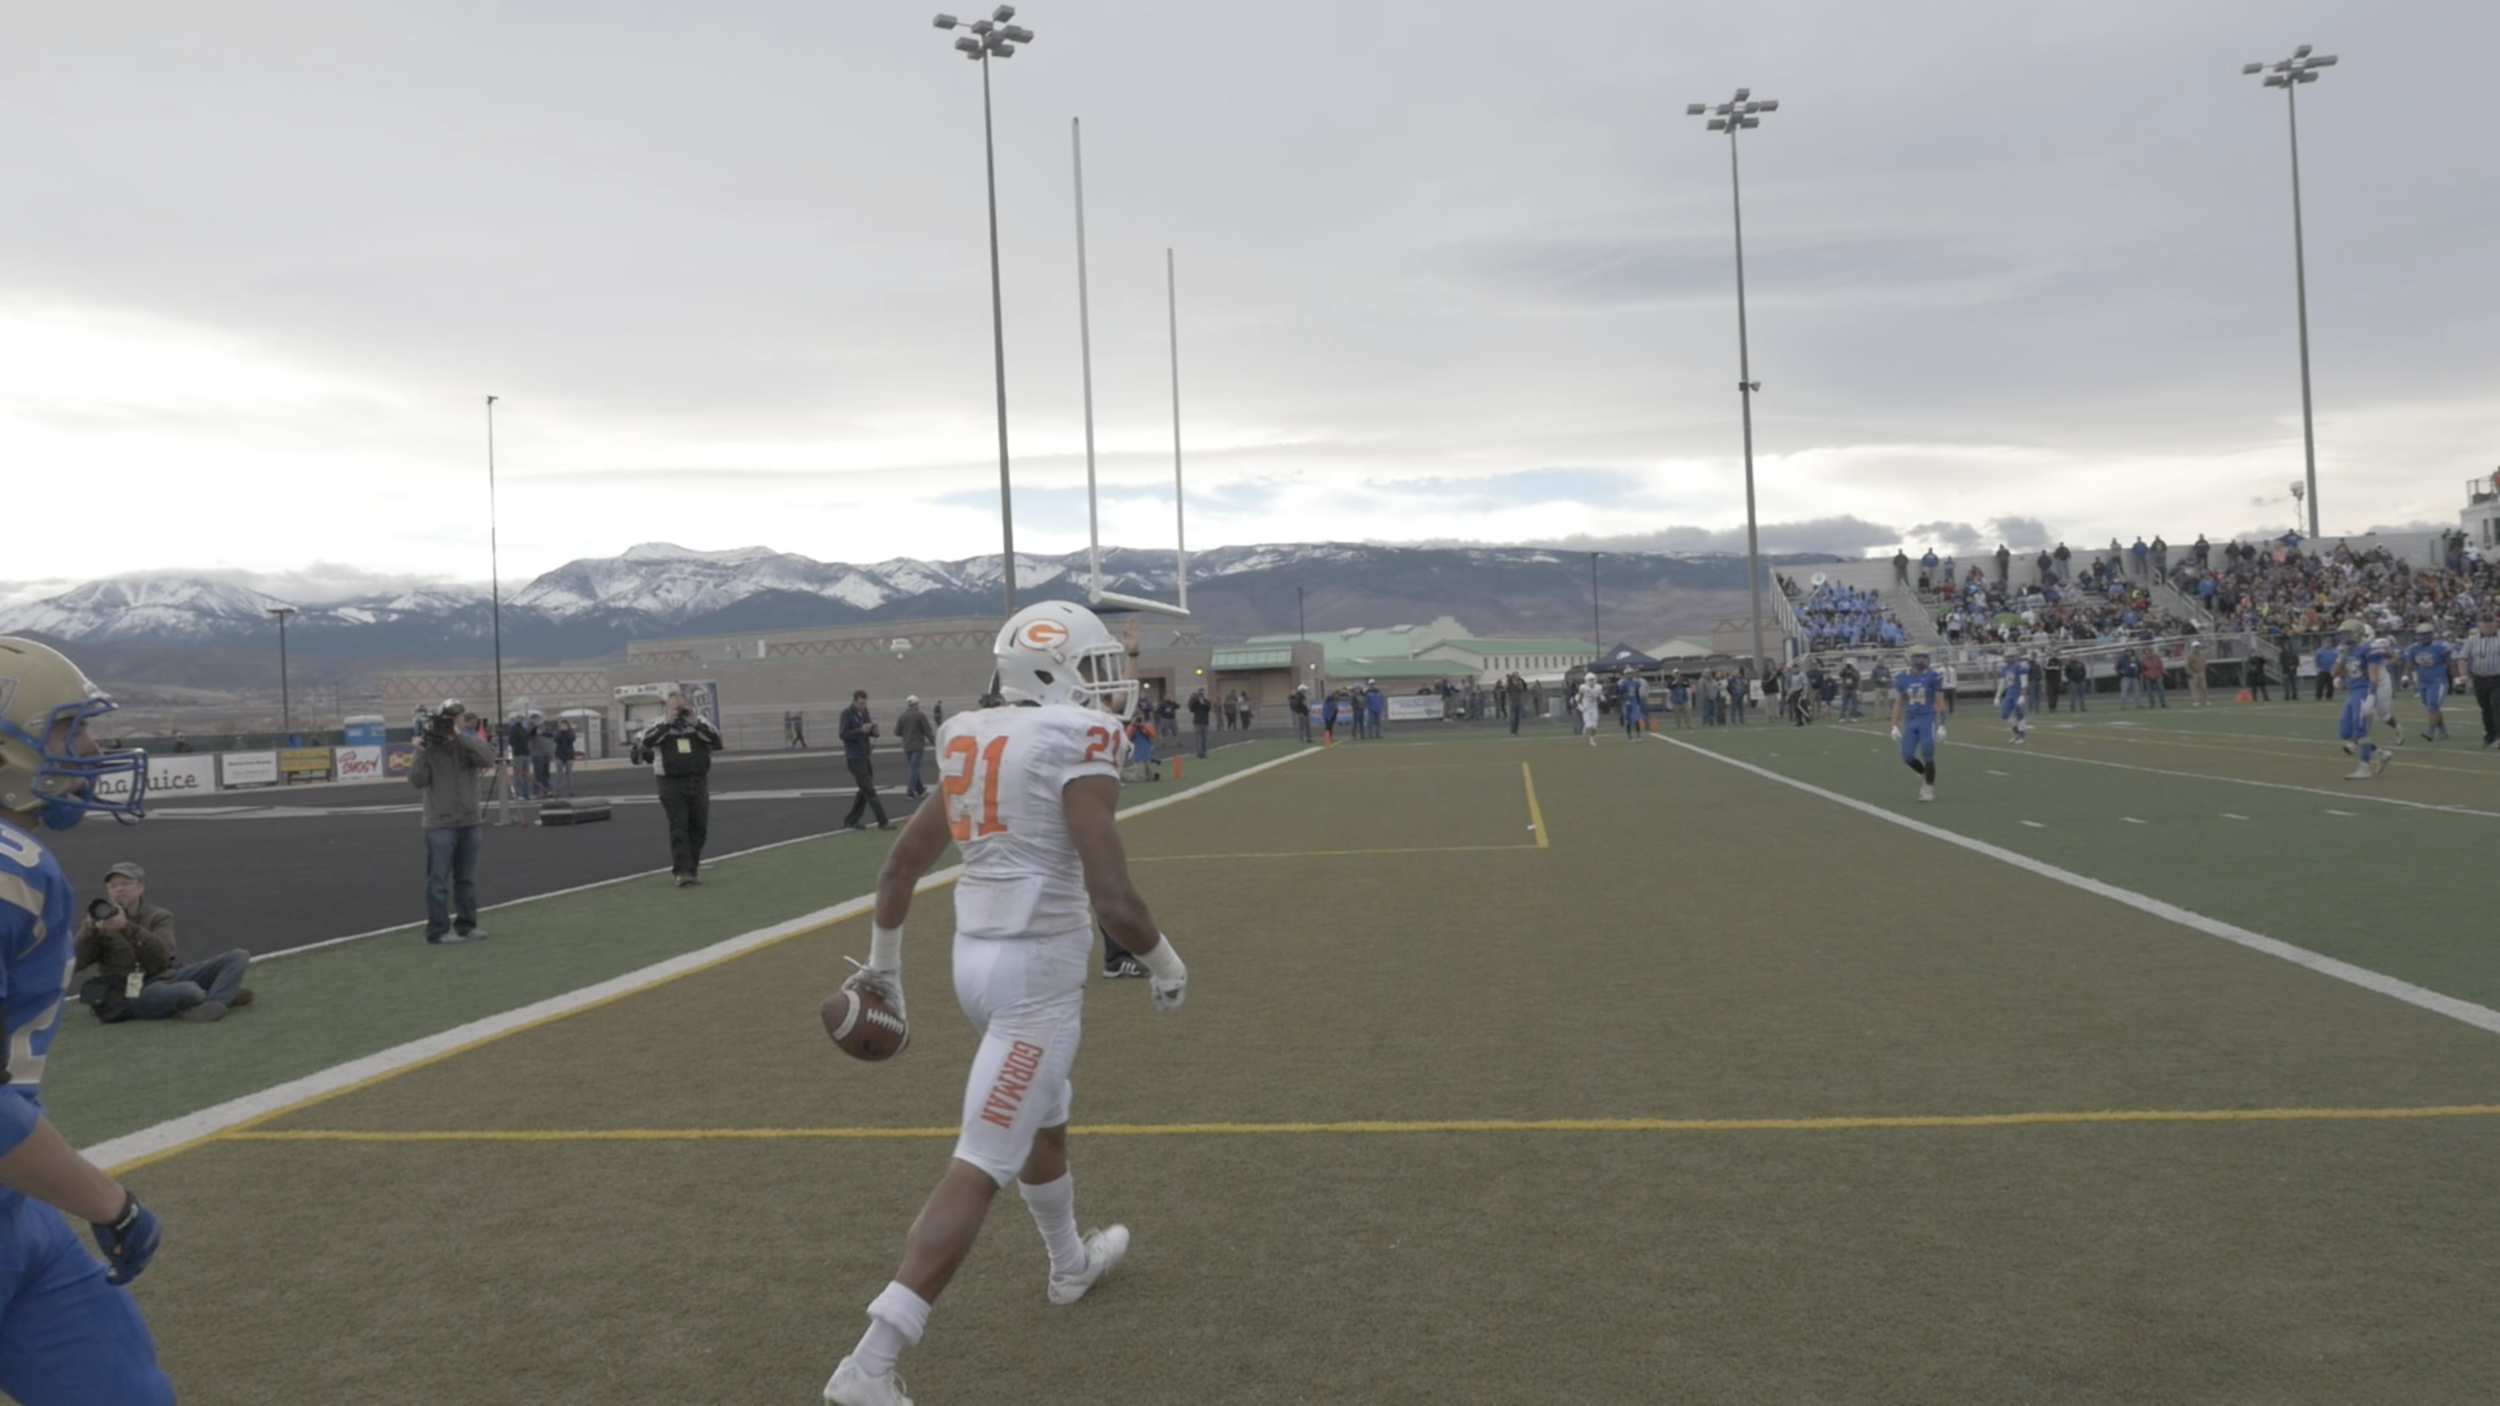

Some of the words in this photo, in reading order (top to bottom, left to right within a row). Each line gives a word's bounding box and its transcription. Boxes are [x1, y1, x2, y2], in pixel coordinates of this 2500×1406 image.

[1907, 687, 1927, 705] 14
[1085, 726, 1121, 768] 21
[146, 768, 199, 791] uice
[942, 734, 1010, 841] 21
[980, 1040, 1043, 1129] GORMAN
